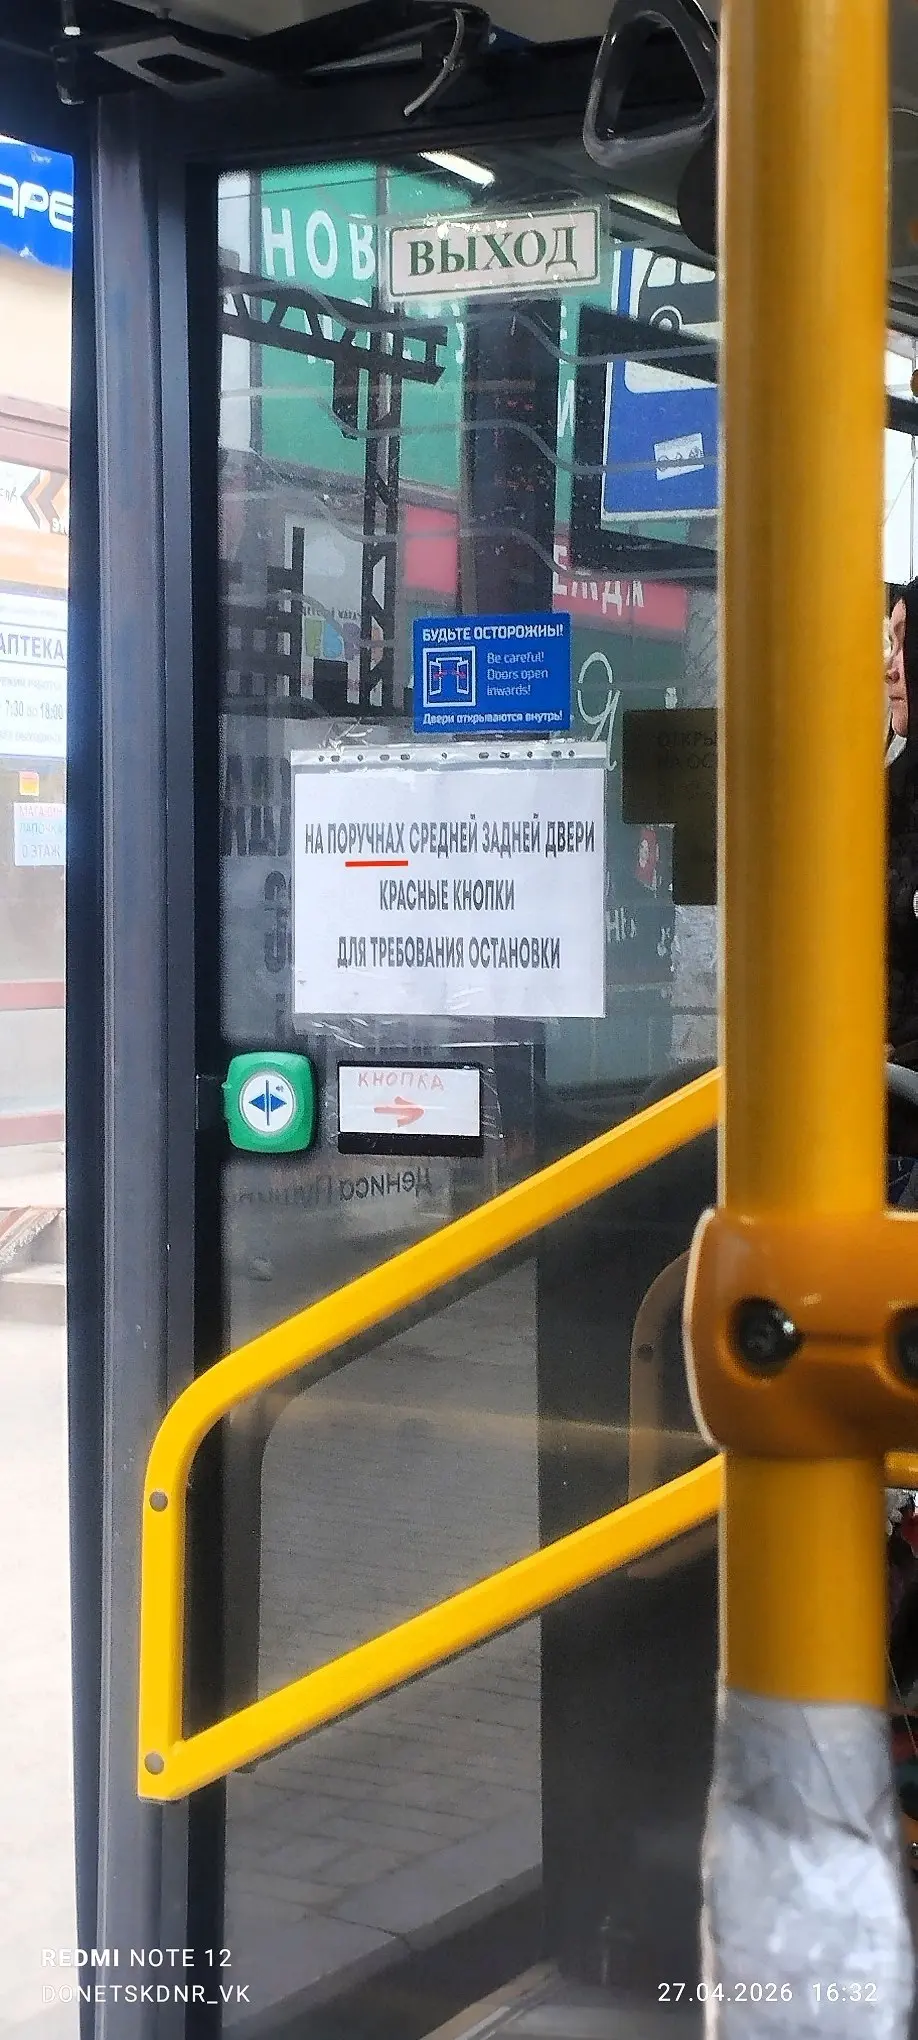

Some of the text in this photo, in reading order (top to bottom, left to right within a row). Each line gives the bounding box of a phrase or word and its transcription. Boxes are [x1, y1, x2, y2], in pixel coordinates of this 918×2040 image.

[408, 226, 578, 276] ВЫХОД
[422, 624, 564, 643] БУДЬТЕ ОСТОРОЖНЫ!
[487, 651, 545, 664] Be careful!
[487, 669, 549, 682] Doors open
[487, 684, 531, 696] inwards!
[423, 710, 563, 725] Двери открываются внутрь!
[305, 813, 595, 858] НА ПОРУЧНАХ СРЕДНЕЙ ЗАДНЕЙ ДВЕРИ
[379, 879, 515, 910] КРАСНЫЕ КНОПКИ
[337, 937, 560, 969] ДЛЯ ТРЕБОВАНИЯ ОСТАНОВКИ
[357, 1071, 444, 1091] КНОПКА
